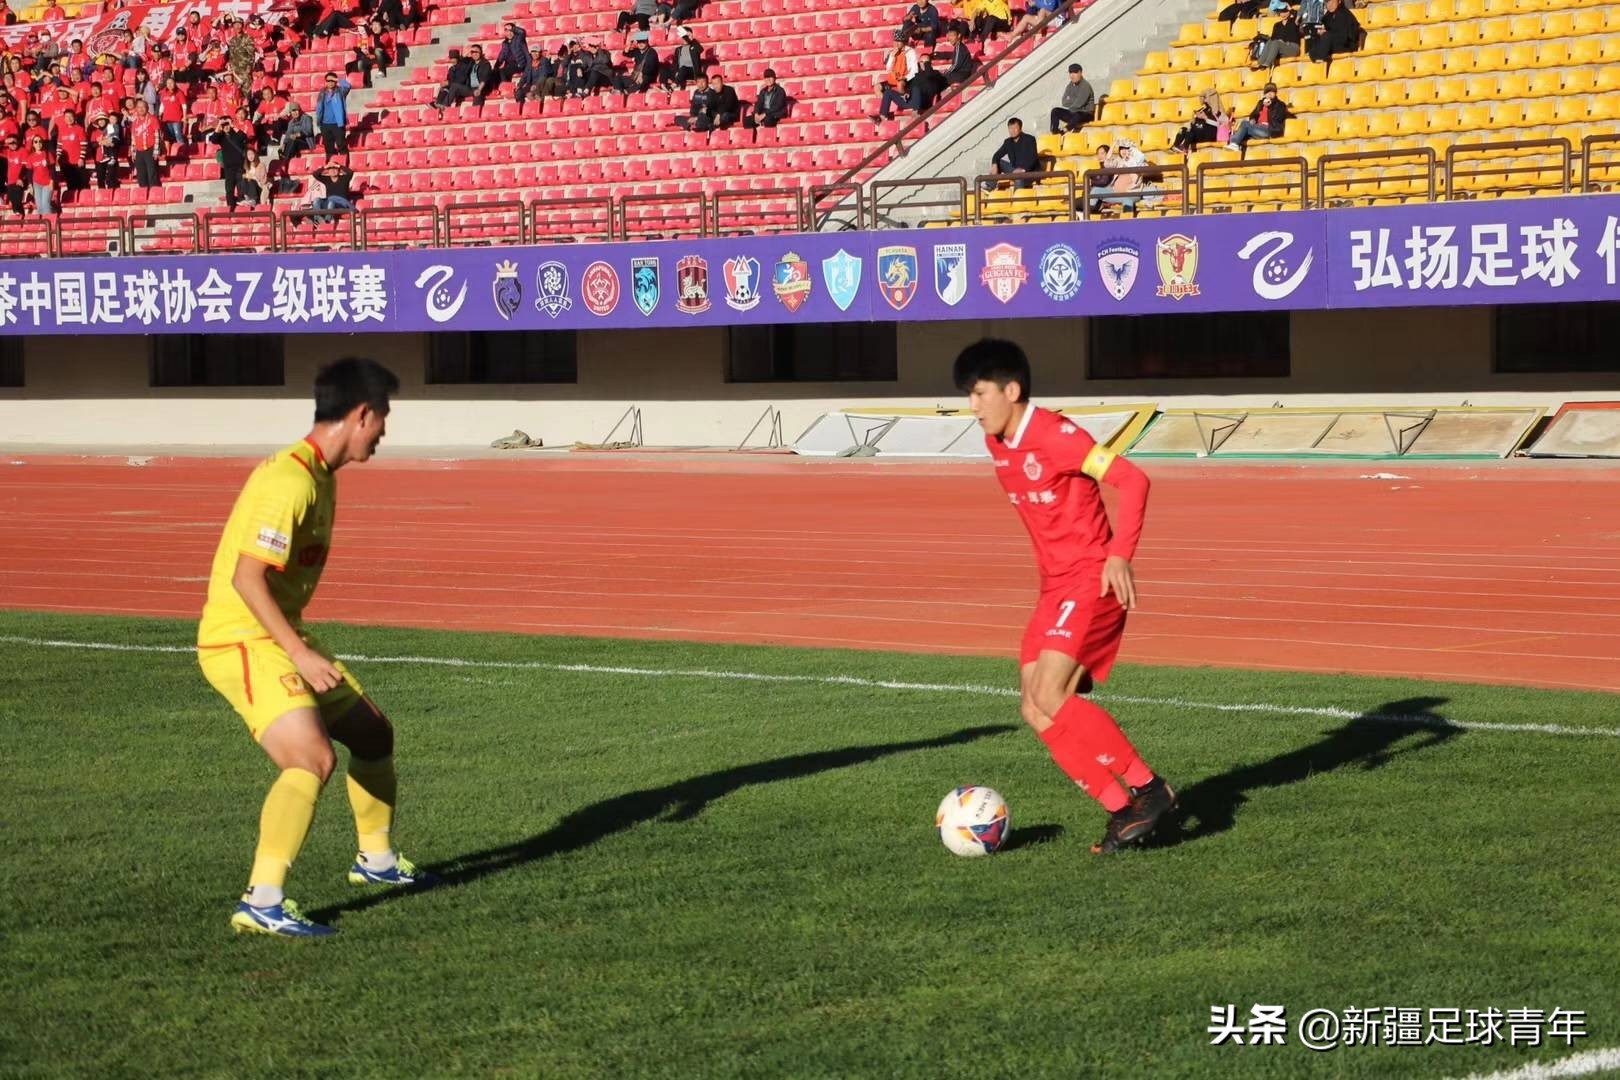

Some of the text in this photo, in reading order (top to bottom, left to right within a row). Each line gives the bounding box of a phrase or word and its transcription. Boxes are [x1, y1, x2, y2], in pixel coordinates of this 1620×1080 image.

[1350, 218, 1581, 291] 弘扬足球
[1055, 600, 1076, 628] 7
